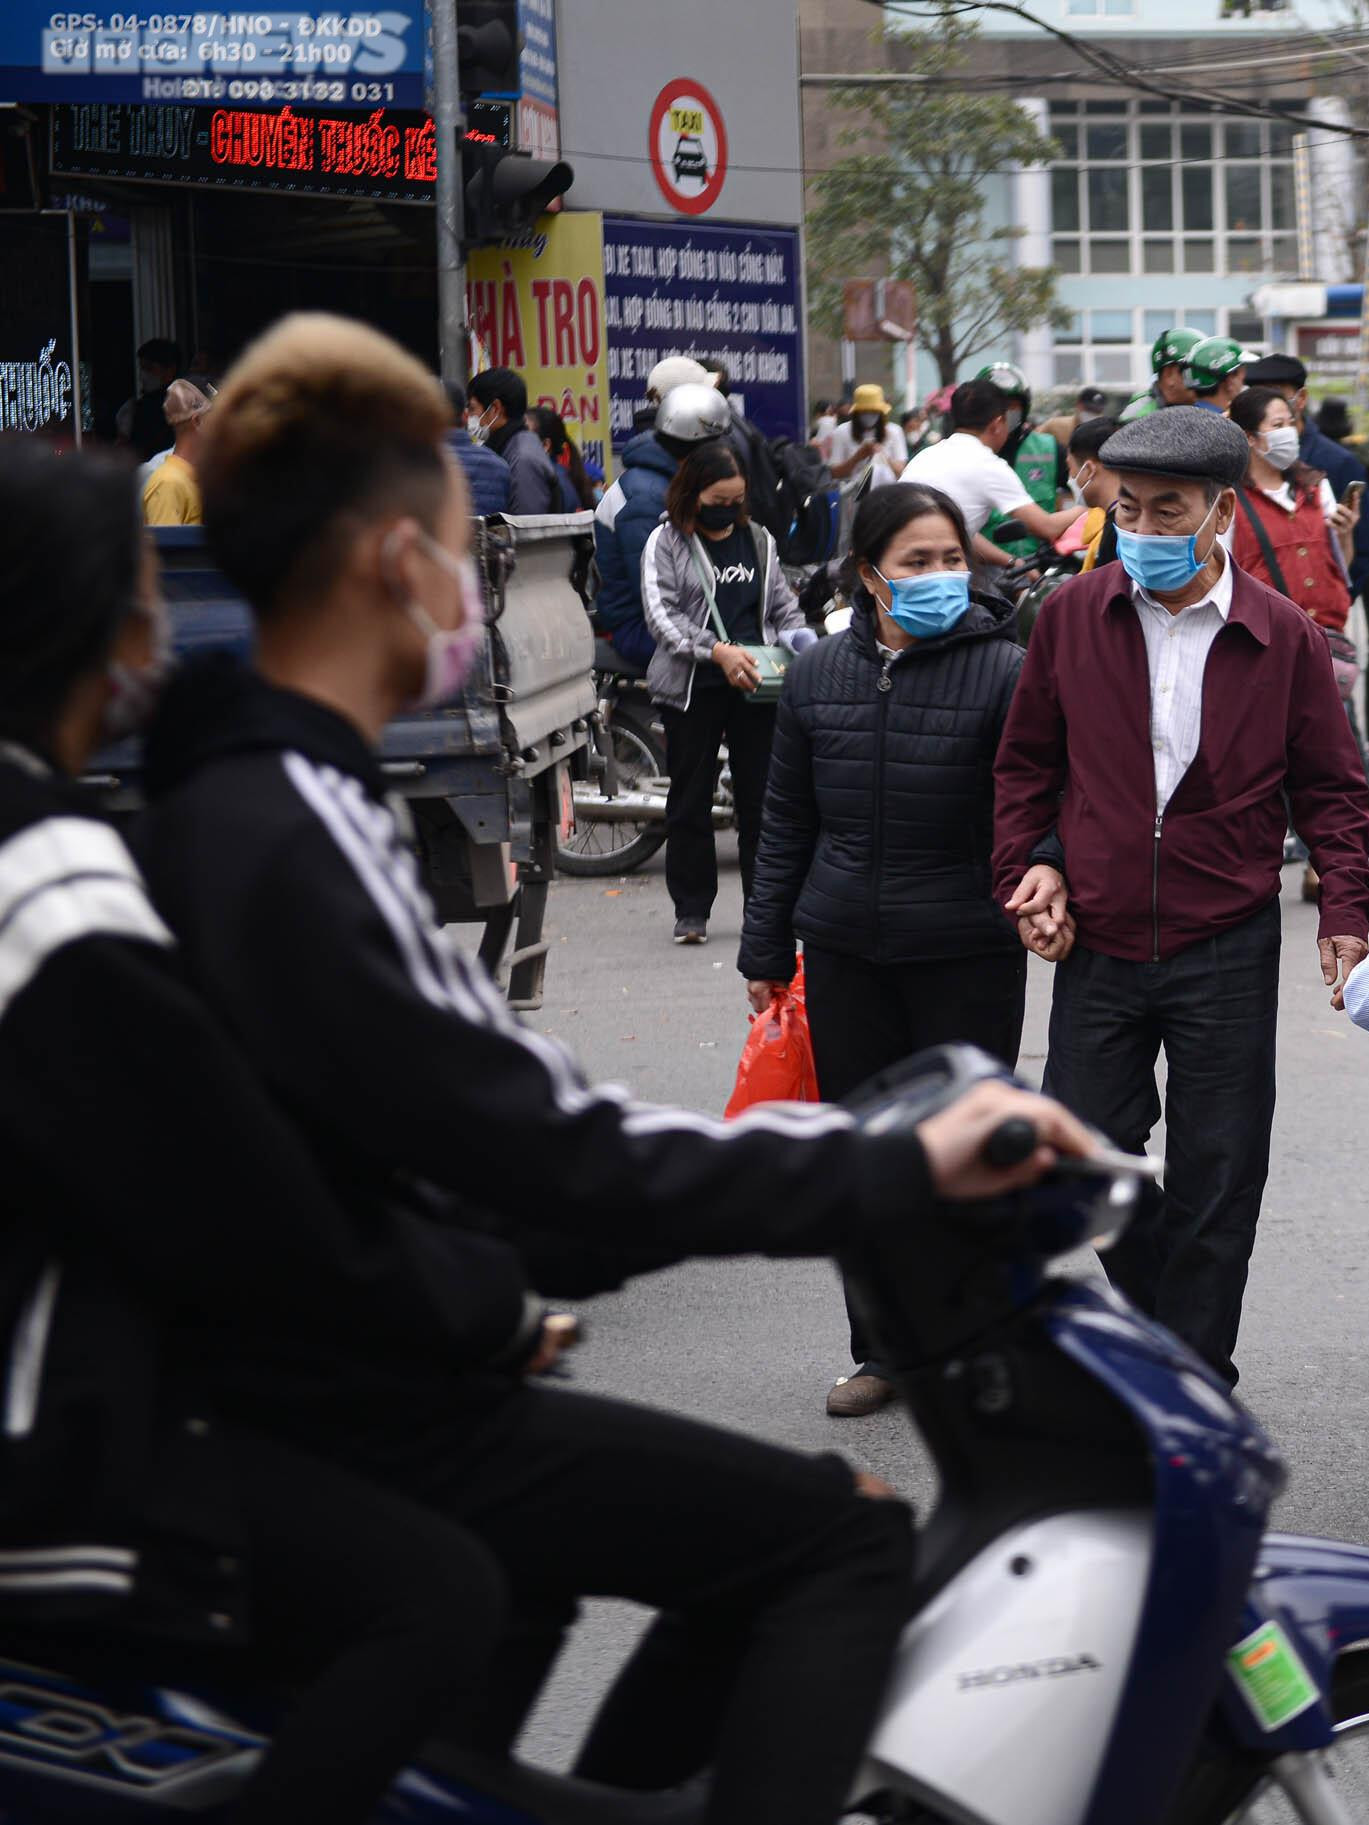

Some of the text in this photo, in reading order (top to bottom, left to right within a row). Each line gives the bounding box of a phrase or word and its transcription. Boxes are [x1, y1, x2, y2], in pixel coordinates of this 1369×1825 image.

[50, 13, 104, 33] GPS:
[198, 41, 256, 62] 6h30
[278, 43, 352, 63] 21h00
[351, 82, 394, 101] 031
[671, 110, 703, 132] TAXI
[617, 244, 631, 277] XE
[532, 277, 600, 387] TRỌ
[957, 1652, 1104, 1691] HONDA
